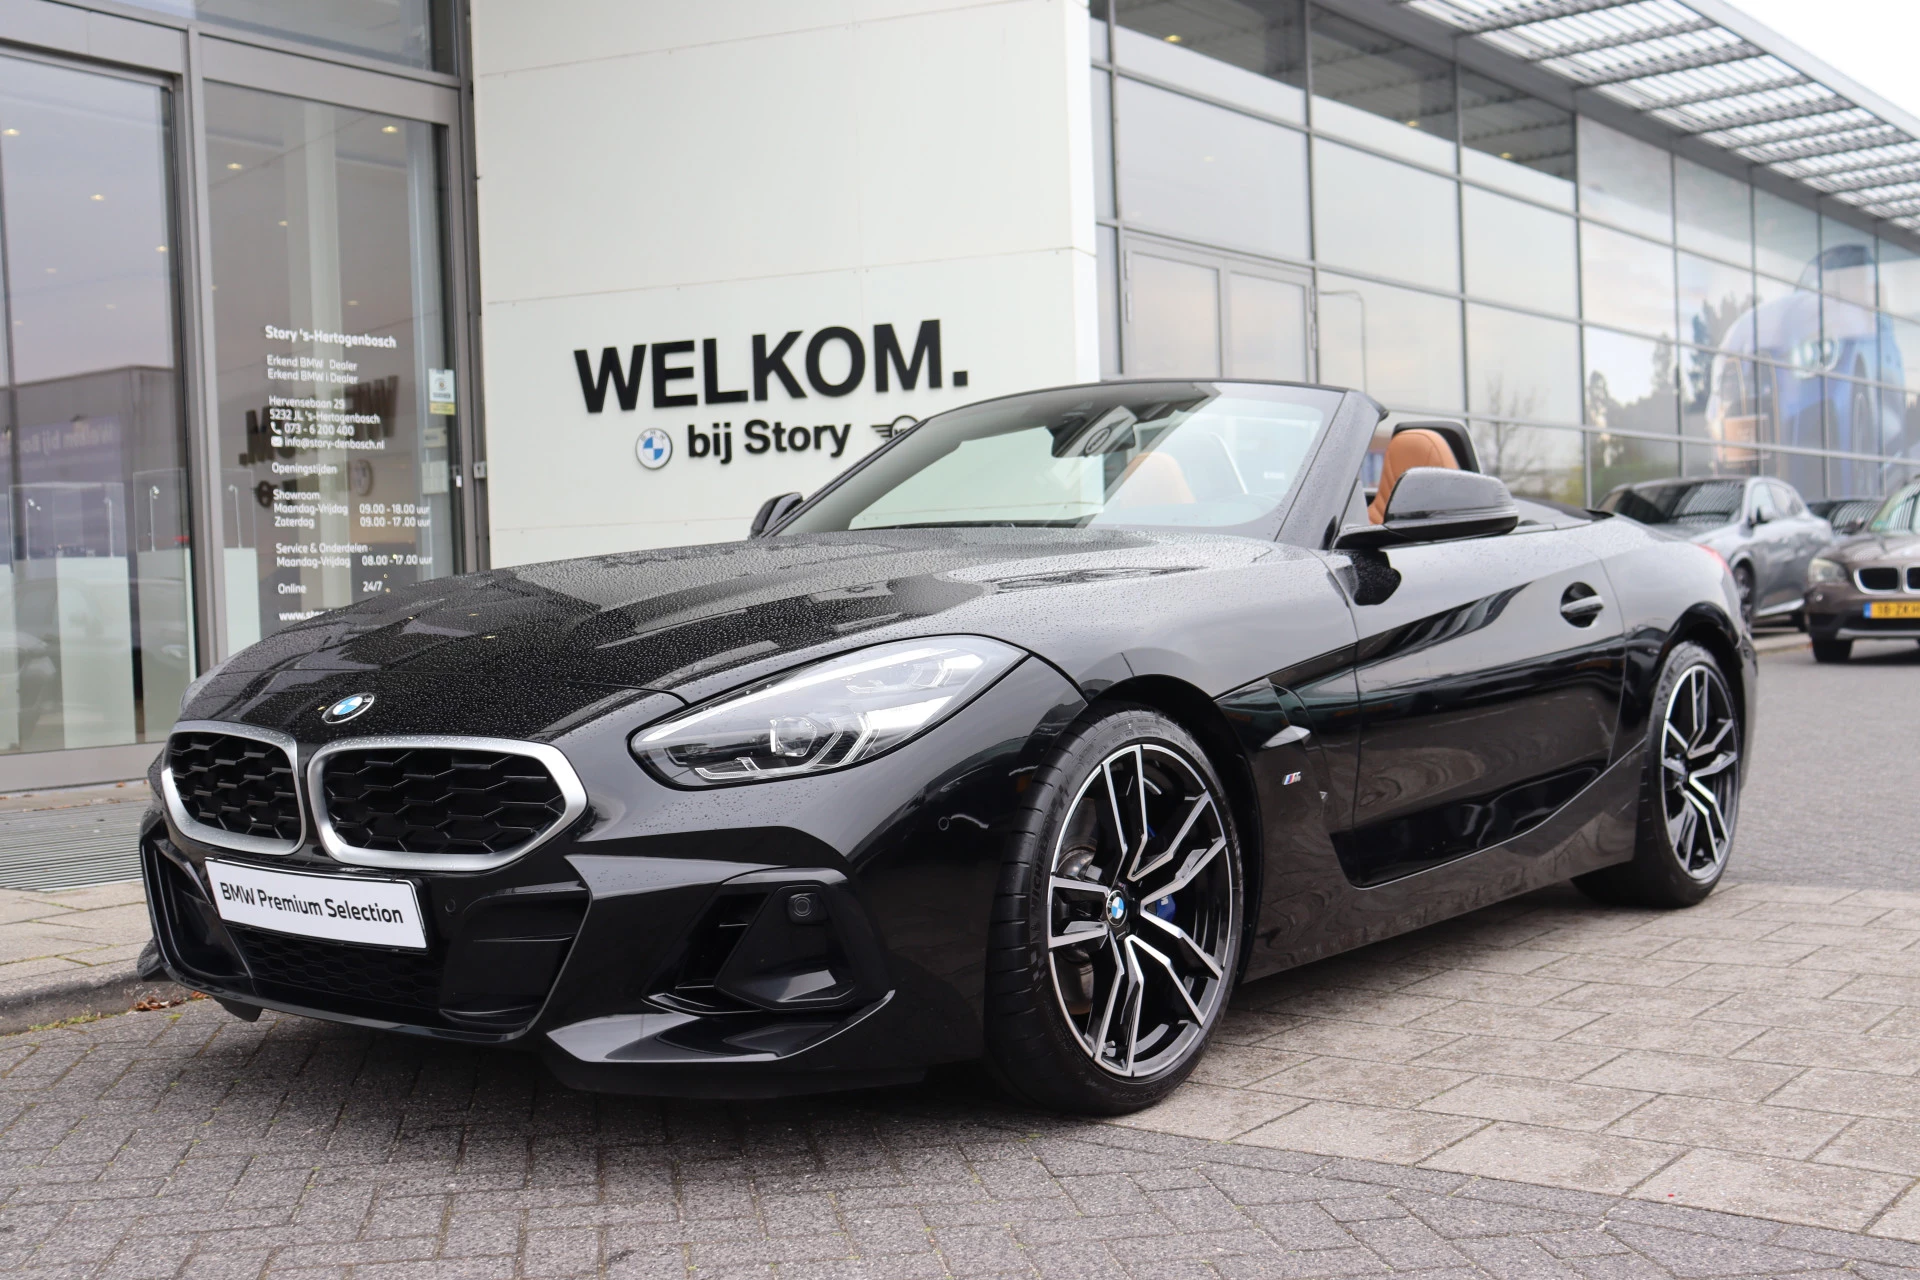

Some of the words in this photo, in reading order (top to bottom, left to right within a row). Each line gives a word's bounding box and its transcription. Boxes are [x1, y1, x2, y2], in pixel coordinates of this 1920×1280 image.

[265, 325, 297, 343] Story
[299, 328, 397, 348] 's-Hertogenbosch
[267, 354, 298, 367] Erkend
[300, 357, 324, 369] BMW
[329, 359, 357, 371] Dealer
[573, 319, 968, 414] WELKOM.
[267, 368, 299, 380] Erkend
[300, 370, 323, 382] BMW
[330, 372, 358, 384] Dealer
[268, 395, 332, 408] Hervensebaan
[333, 398, 345, 409] 29
[269, 408, 292, 421] 5232
[284, 423, 302, 434] 073
[309, 424, 316, 435] 6
[317, 424, 335, 436] 200
[336, 425, 355, 436] 400
[284, 437, 385, 450] info@story-denbosch.nl
[687, 422, 732, 464] bij
[744, 419, 852, 458] Story
[271, 462, 338, 476] Openingstijden
[273, 489, 320, 500] Showroom
[273, 503, 349, 516] Maandag-Vrijdag
[359, 504, 384, 515] 09.00
[392, 503, 415, 514] 18.00
[416, 505, 431, 514] uur
[274, 516, 315, 529] Zaterdag
[360, 516, 385, 527] 09.00
[417, 519, 431, 527] uur
[276, 543, 308, 554] Service
[309, 544, 318, 554] &
[319, 543, 368, 553] Onderdelen
[277, 556, 350, 568] Maandag-Vrijdag
[362, 555, 388, 566] 08.00
[419, 556, 433, 565] uur
[278, 583, 307, 595] Online
[362, 581, 383, 592] 24/7
[220, 882, 254, 906] BMW
[258, 888, 323, 916] Premium
[327, 898, 404, 924] Selection
